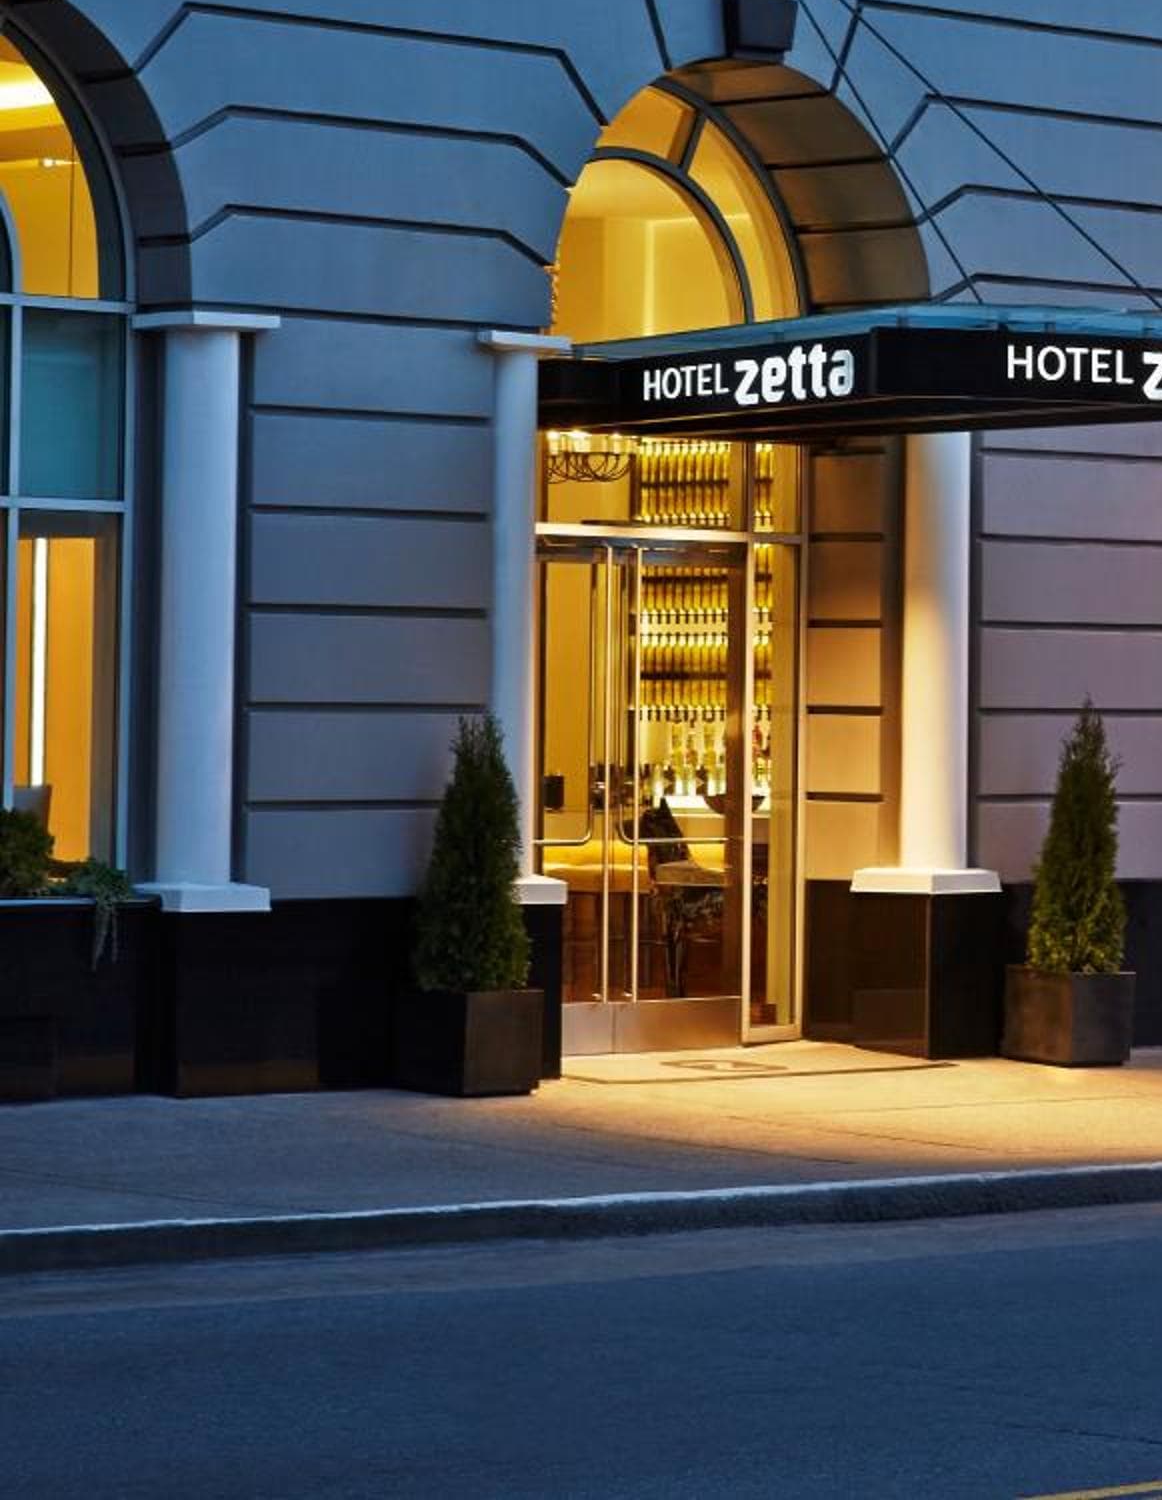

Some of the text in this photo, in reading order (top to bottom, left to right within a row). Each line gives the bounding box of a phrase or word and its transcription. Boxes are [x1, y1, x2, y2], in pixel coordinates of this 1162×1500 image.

[643, 343, 854, 406] HOTEL zetta
[1007, 344, 1134, 386] HOTEL
